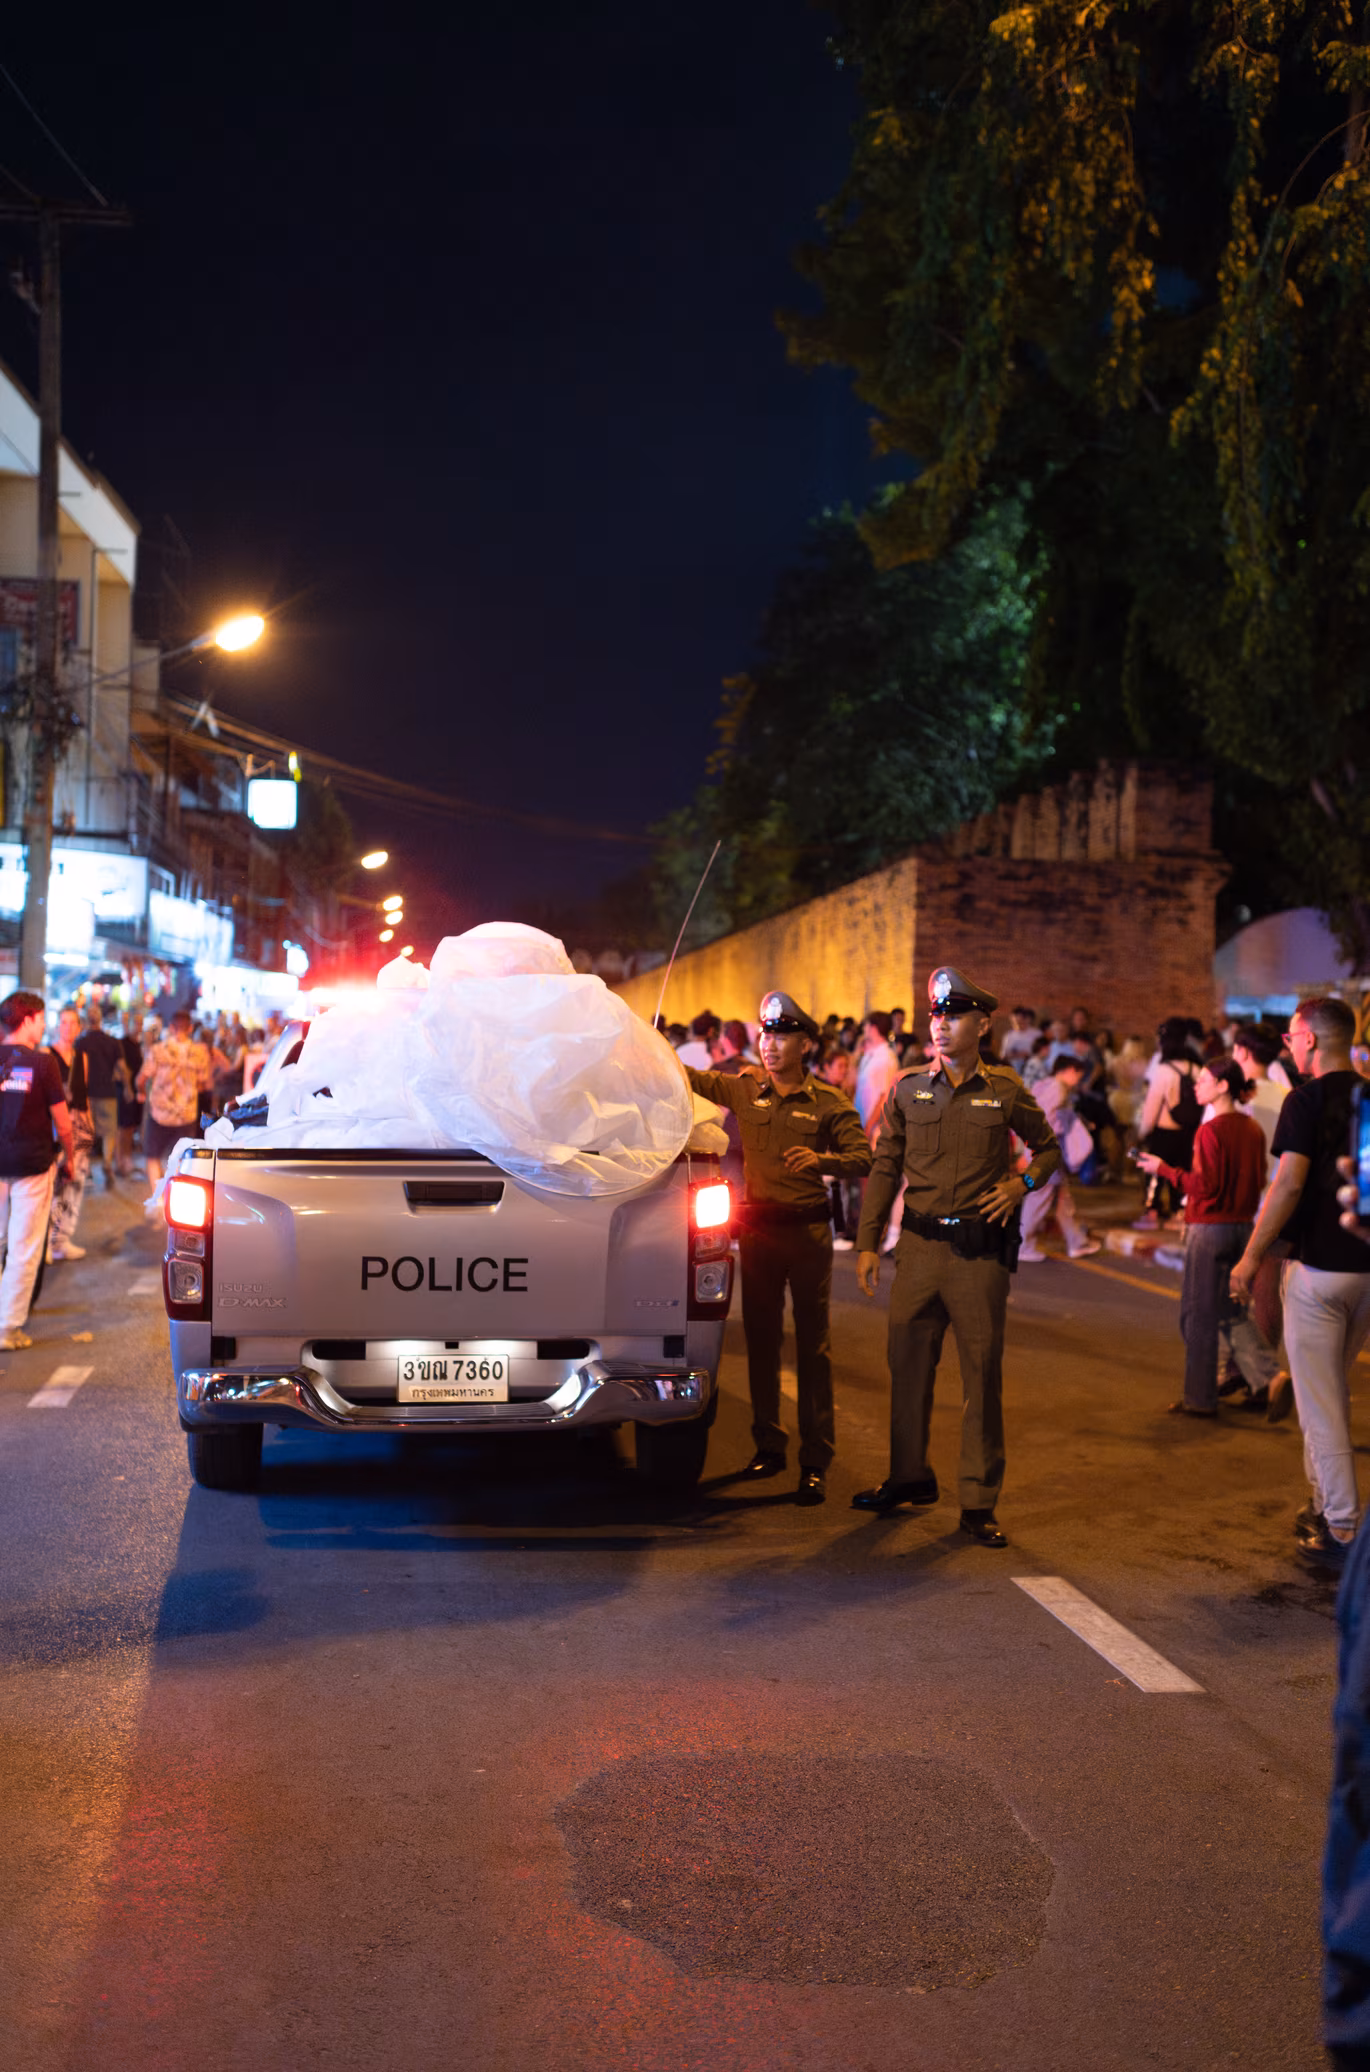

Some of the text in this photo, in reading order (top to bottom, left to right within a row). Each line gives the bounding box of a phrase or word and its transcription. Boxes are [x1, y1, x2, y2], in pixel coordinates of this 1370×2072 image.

[361, 1256, 529, 1292] POLICE
[219, 1283, 263, 1292] ISUZU
[453, 1360, 504, 1381] 7360
[411, 1388, 495, 1400] กรุงเทพมหานคร
